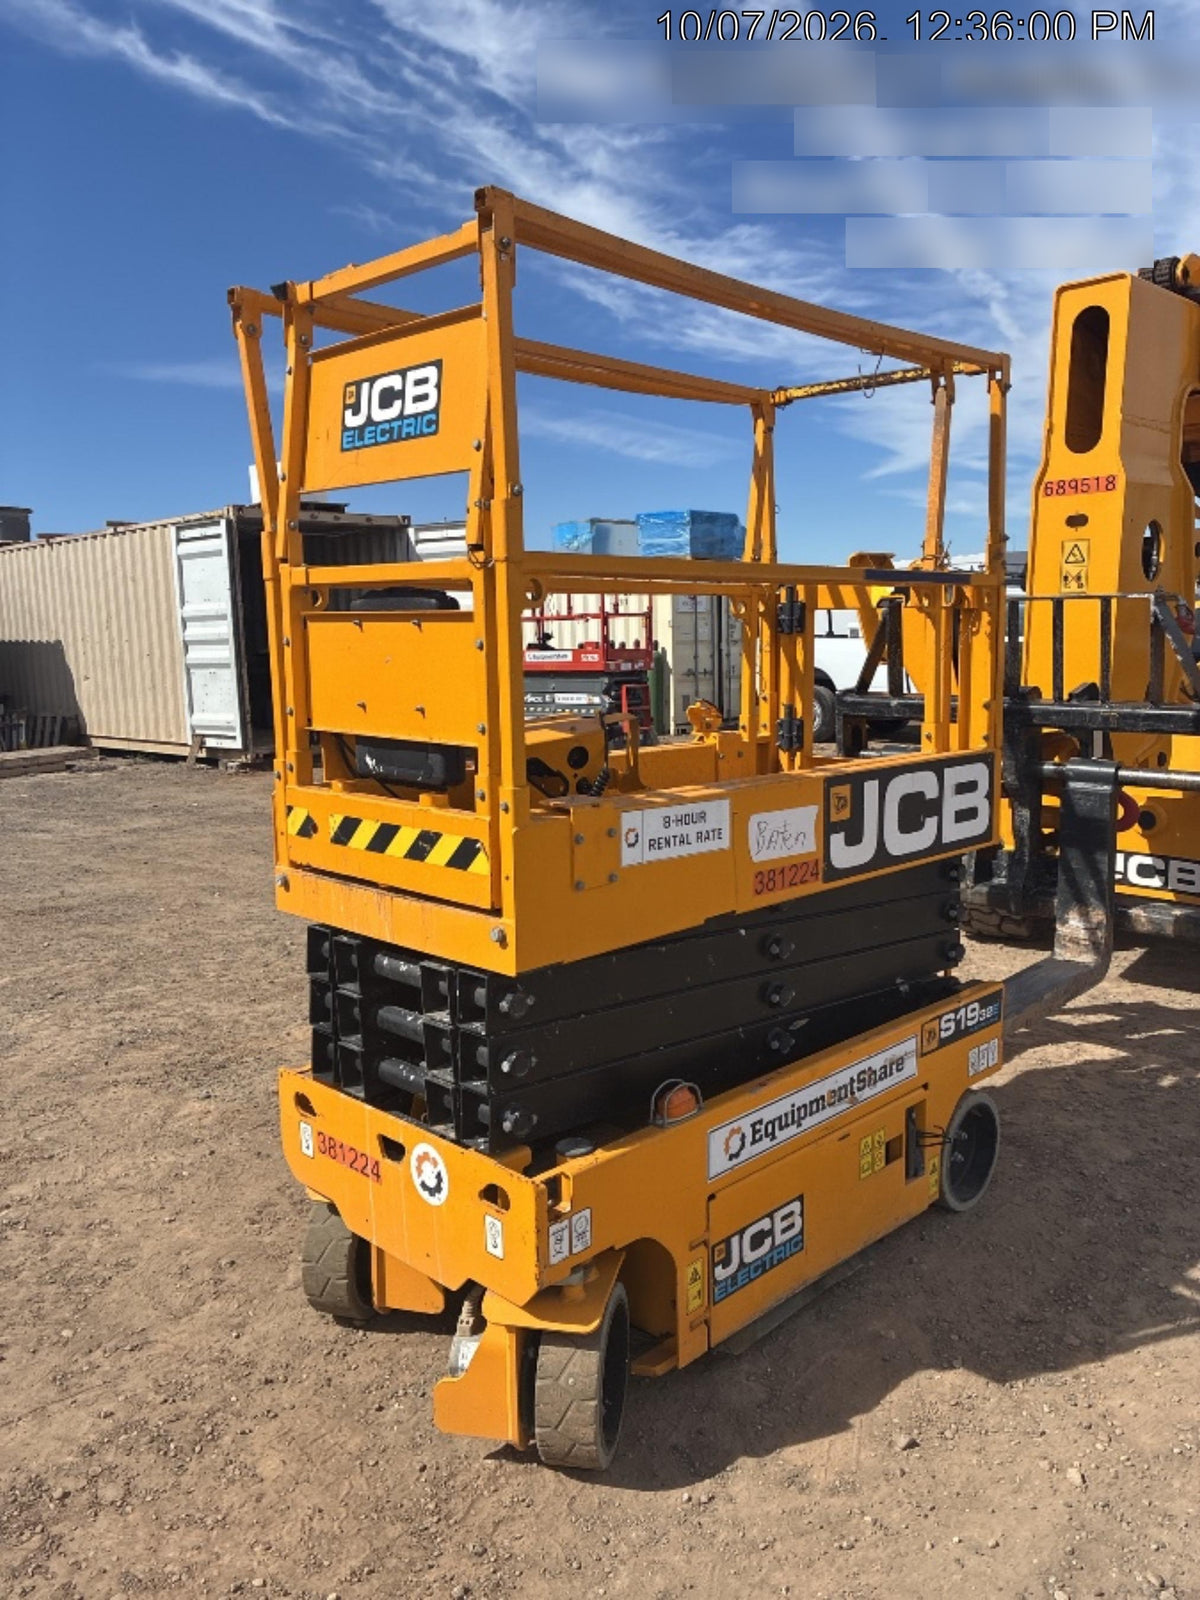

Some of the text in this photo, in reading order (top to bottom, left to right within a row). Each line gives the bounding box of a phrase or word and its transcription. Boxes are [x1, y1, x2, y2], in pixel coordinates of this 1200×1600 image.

[344, 366, 438, 428] JCB
[342, 413, 437, 450] ELECTRIC
[1044, 474, 1117, 497] 689518
[648, 828, 723, 852] RENTAL RATE
[662, 810, 707, 829] 8-HOUR
[830, 762, 990, 869] JCB
[754, 859, 819, 895] 381224
[749, 1055, 906, 1148] EquipmentShare
[317, 1131, 381, 1183] 381224
[714, 1200, 803, 1281] JCB
[714, 1234, 804, 1303] ELECTRIC
